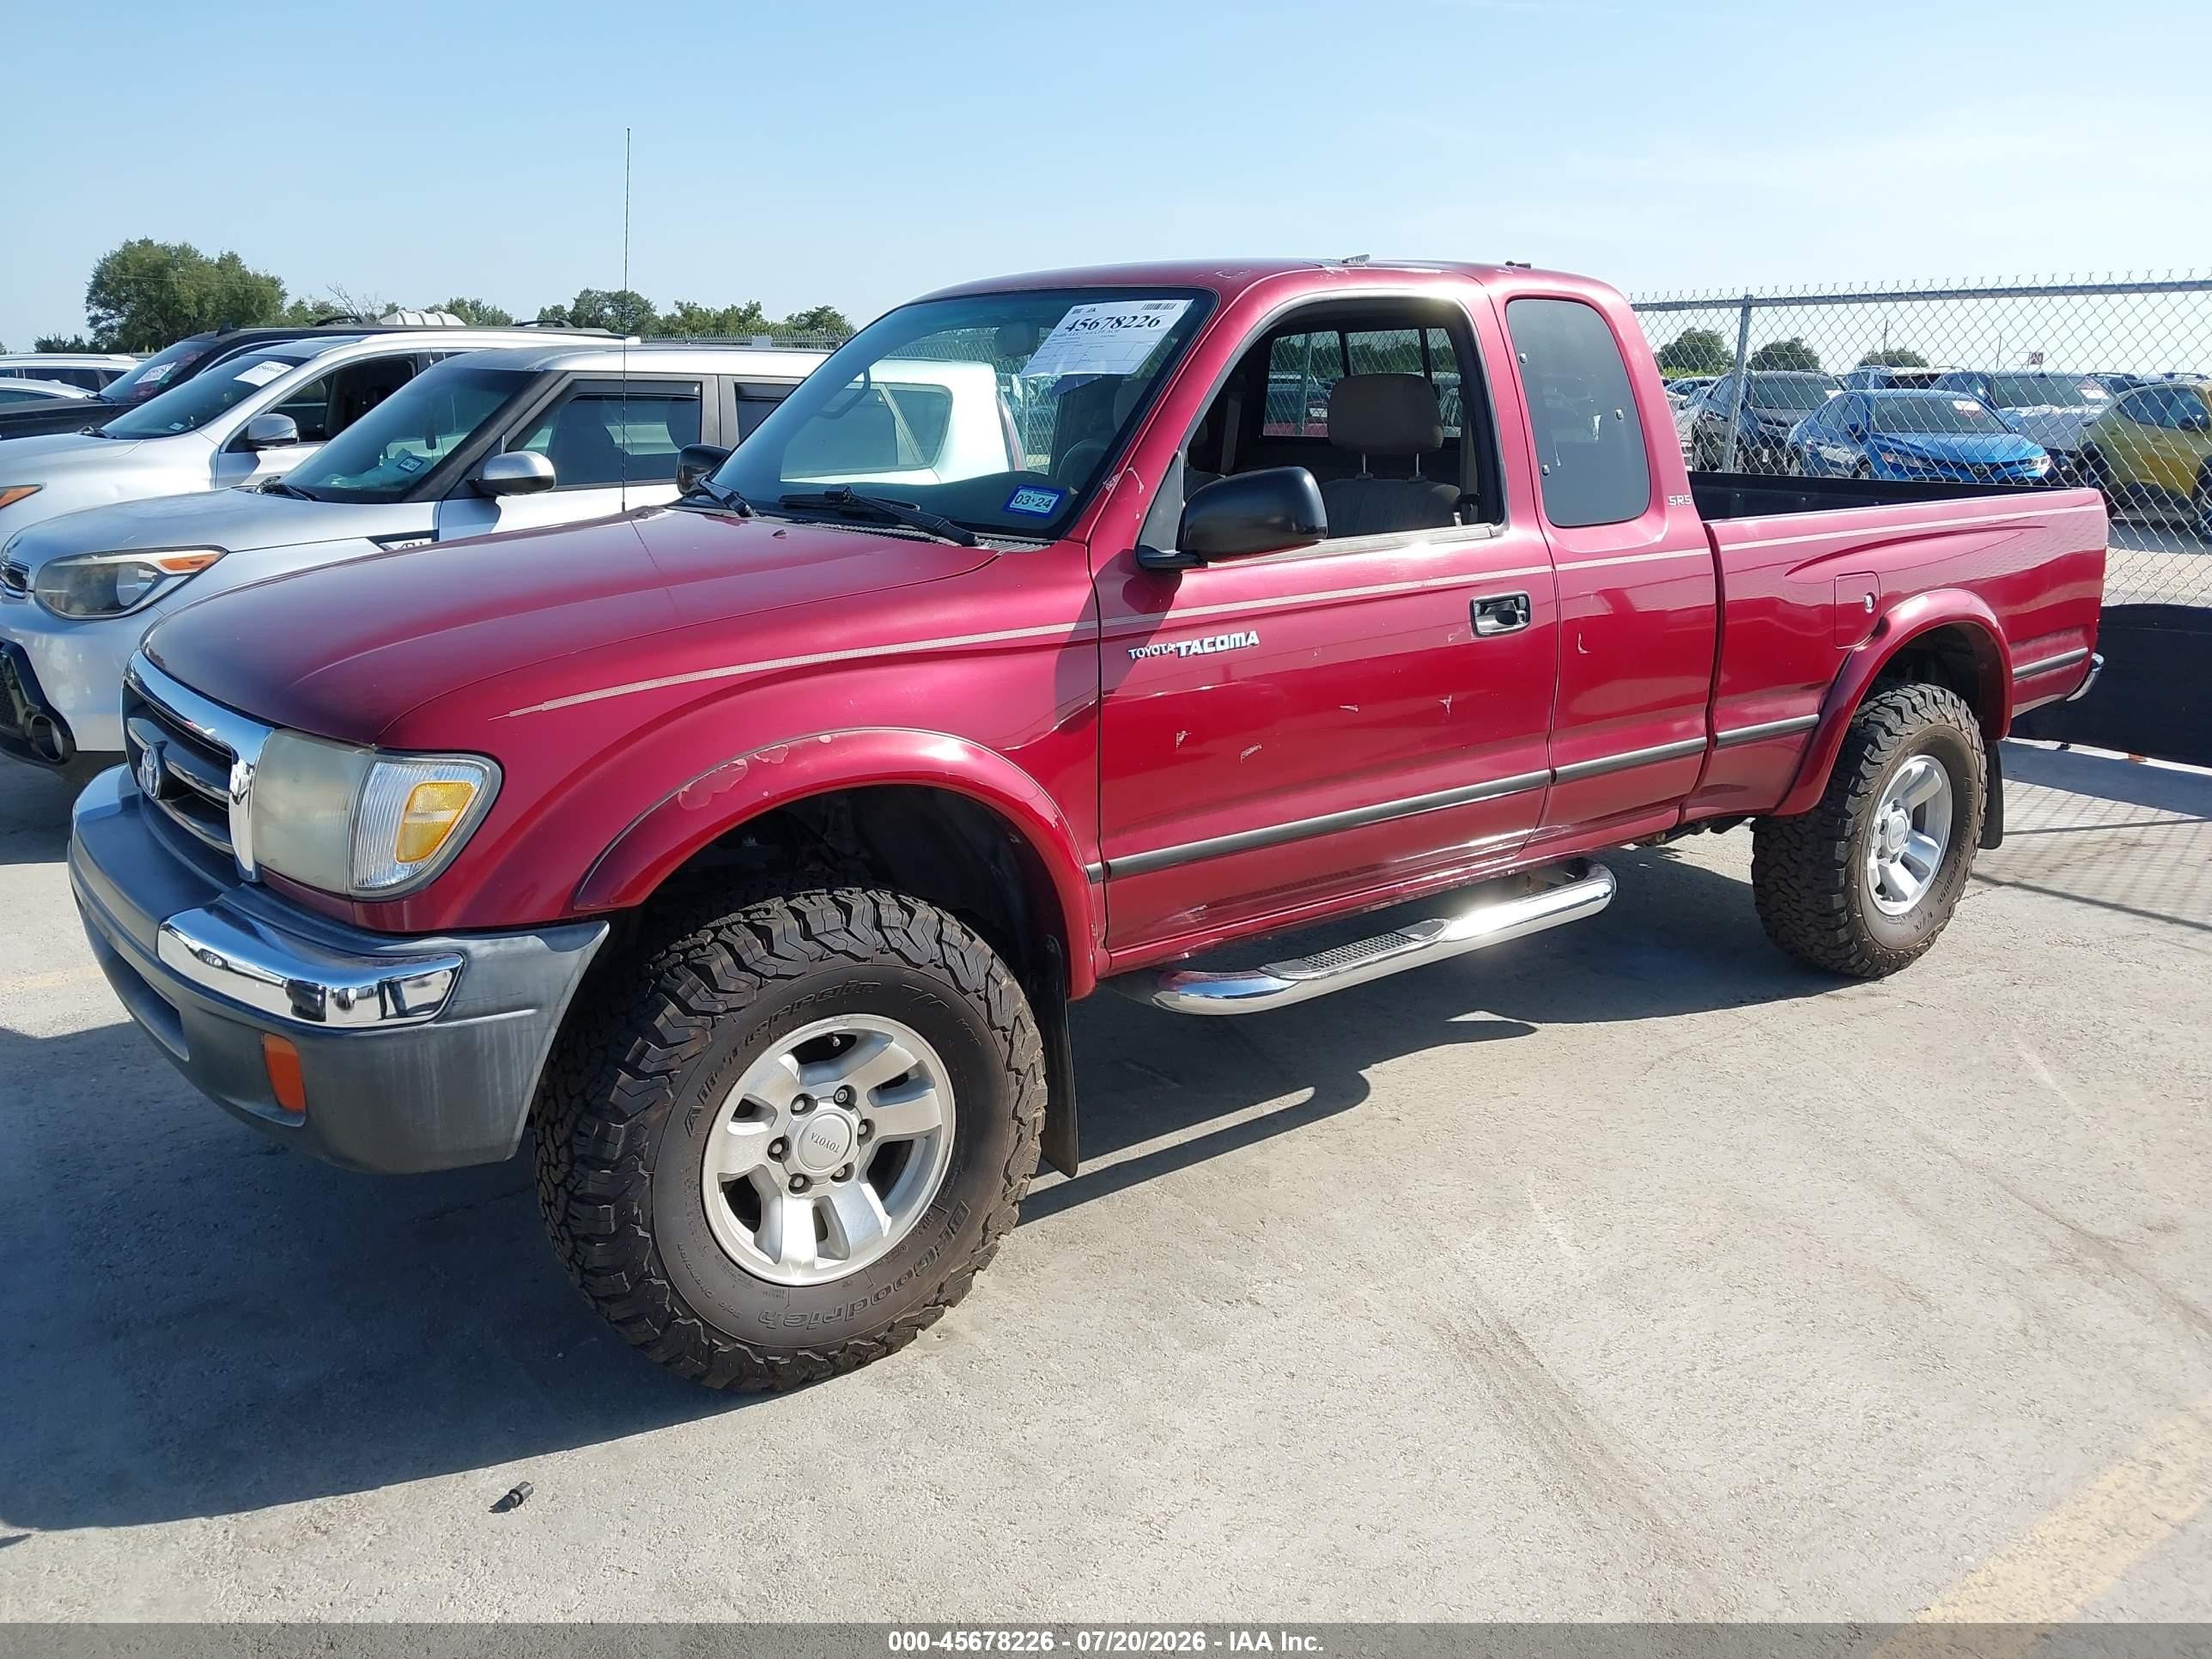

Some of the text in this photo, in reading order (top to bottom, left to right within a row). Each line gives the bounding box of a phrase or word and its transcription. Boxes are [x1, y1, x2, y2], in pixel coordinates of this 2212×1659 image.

[1065, 314, 1165, 332] 45678226
[1014, 494, 1053, 508] 03 24
[1127, 630, 1260, 659] TOYOTA TACOMA
[811, 1132, 840, 1154] TOYOTA
